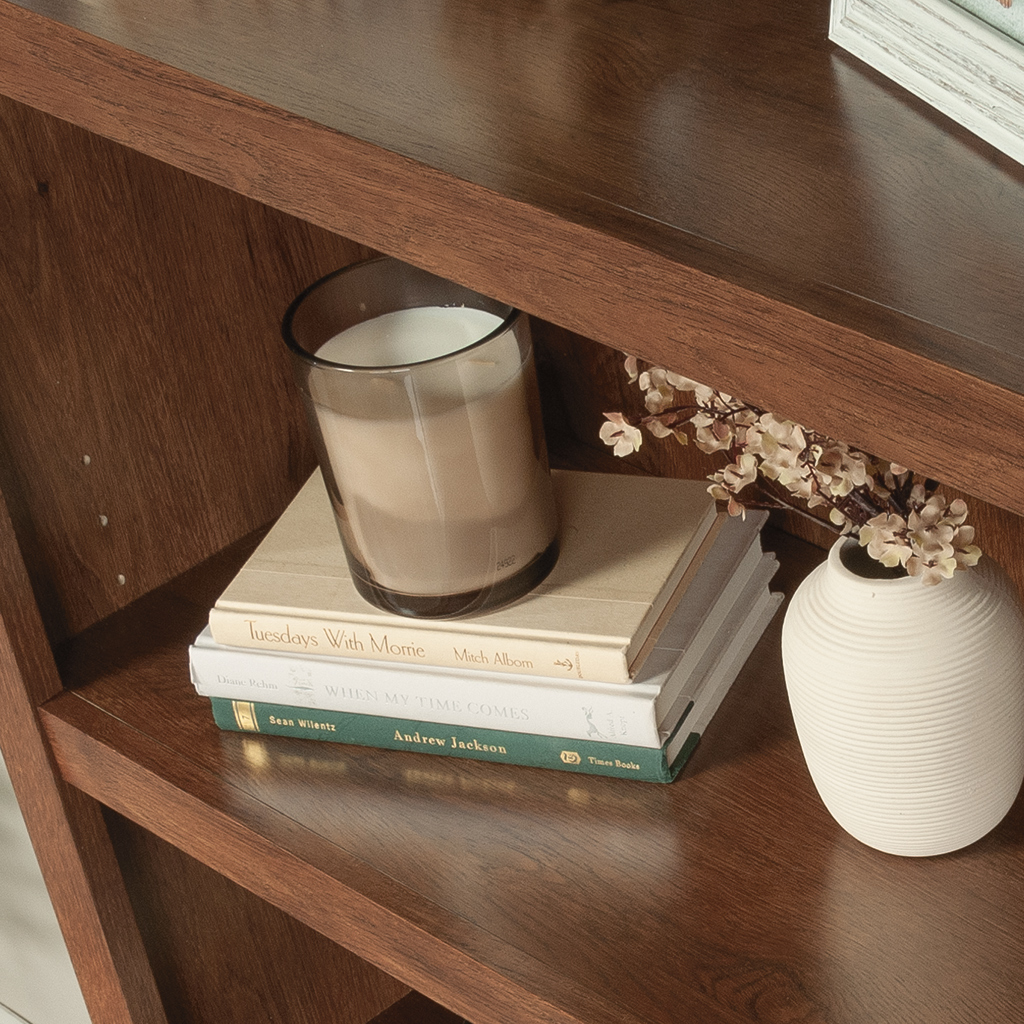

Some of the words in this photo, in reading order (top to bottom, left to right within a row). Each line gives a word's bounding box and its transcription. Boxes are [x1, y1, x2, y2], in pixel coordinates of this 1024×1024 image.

[243, 619, 319, 649] Tuesdays
[322, 627, 365, 652] With
[368, 633, 426, 658] Morrie
[453, 647, 489, 665] Mitch
[493, 652, 534, 669] Albom
[325, 685, 378, 701] WHEN
[384, 692, 410, 706] MY
[415, 695, 463, 713] TIME
[467, 701, 531, 721] COMES
[269, 715, 294, 728] Sean
[297, 717, 337, 733] Wilentz
[393, 729, 446, 747] Andrew
[450, 736, 508, 755] Jackson
[587, 756, 614, 768] Times
[614, 759, 640, 771] Books
